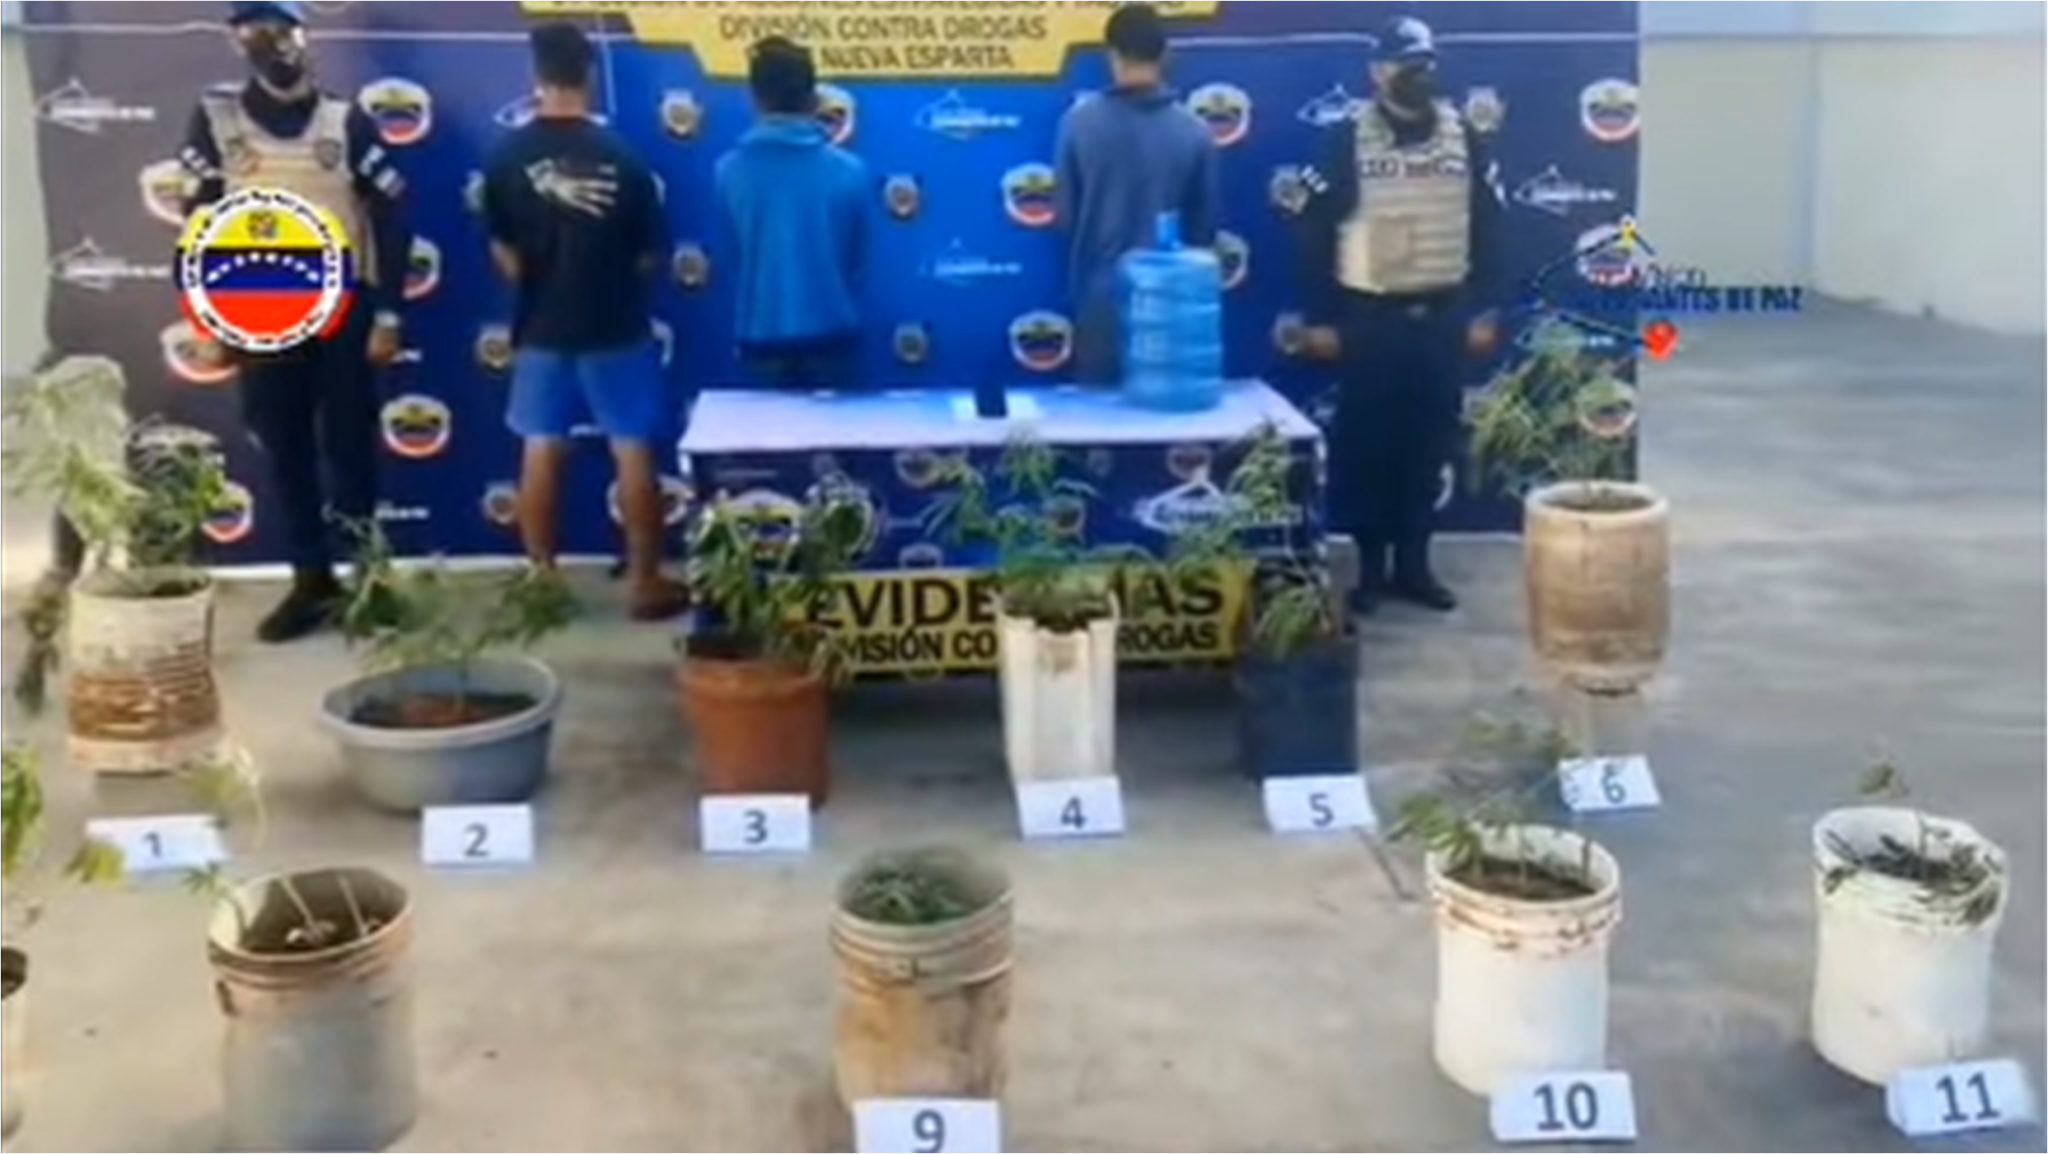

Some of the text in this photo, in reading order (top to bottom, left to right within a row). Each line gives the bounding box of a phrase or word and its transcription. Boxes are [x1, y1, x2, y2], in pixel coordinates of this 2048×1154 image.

[837, 15, 938, 40] CONTRA
[943, 15, 1047, 40] DROGAS
[820, 46, 1016, 69] NUEVA ESPARTA
[1601, 761, 1627, 804] 6
[742, 808, 769, 845] 3
[1059, 796, 1086, 830] 4
[1308, 793, 1335, 828] 5
[140, 831, 164, 859] 1
[462, 822, 490, 859] 2
[1532, 1080, 1601, 1132] 10
[1934, 1070, 2003, 1125] 11
[912, 1107, 946, 1154] 9
